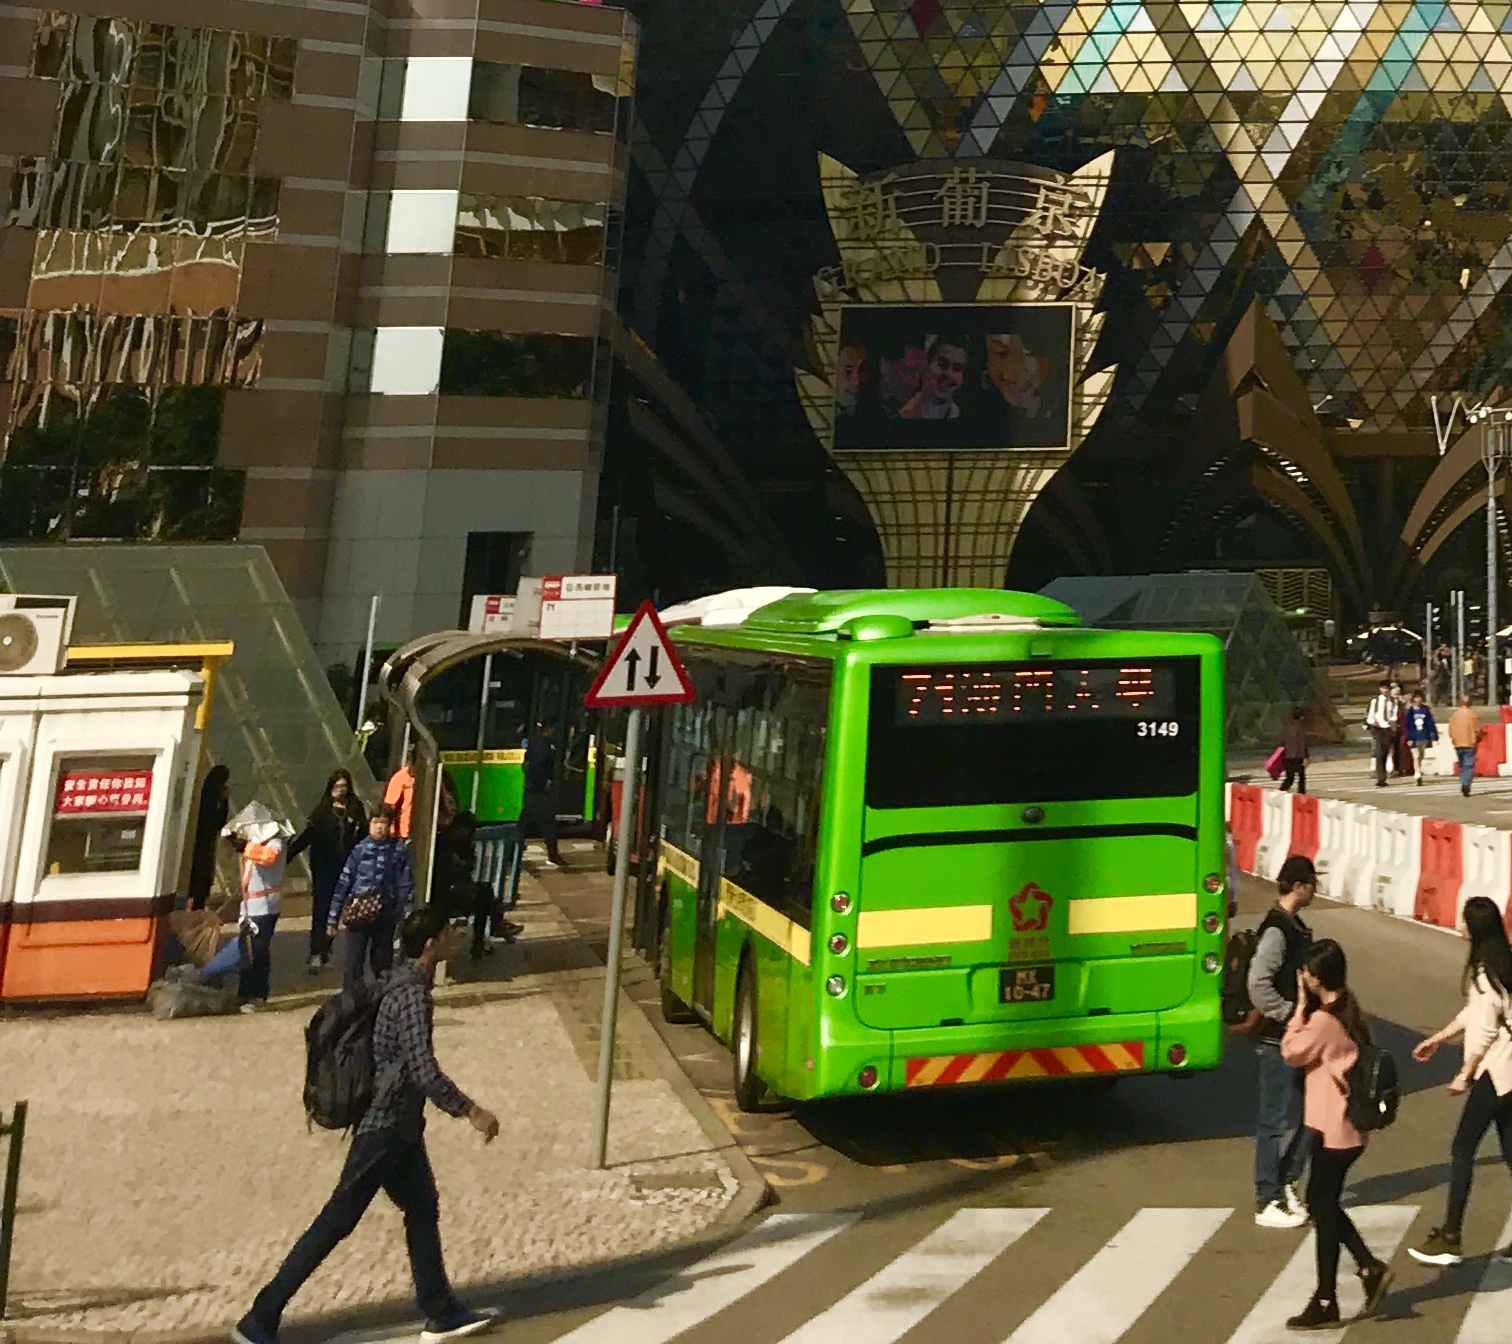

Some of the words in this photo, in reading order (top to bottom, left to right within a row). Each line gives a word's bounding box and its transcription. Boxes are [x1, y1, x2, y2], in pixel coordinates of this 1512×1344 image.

[841, 167, 1088, 239] 新葡京
[980, 242, 1100, 297] LISBOA
[1137, 721, 1179, 737] 3149
